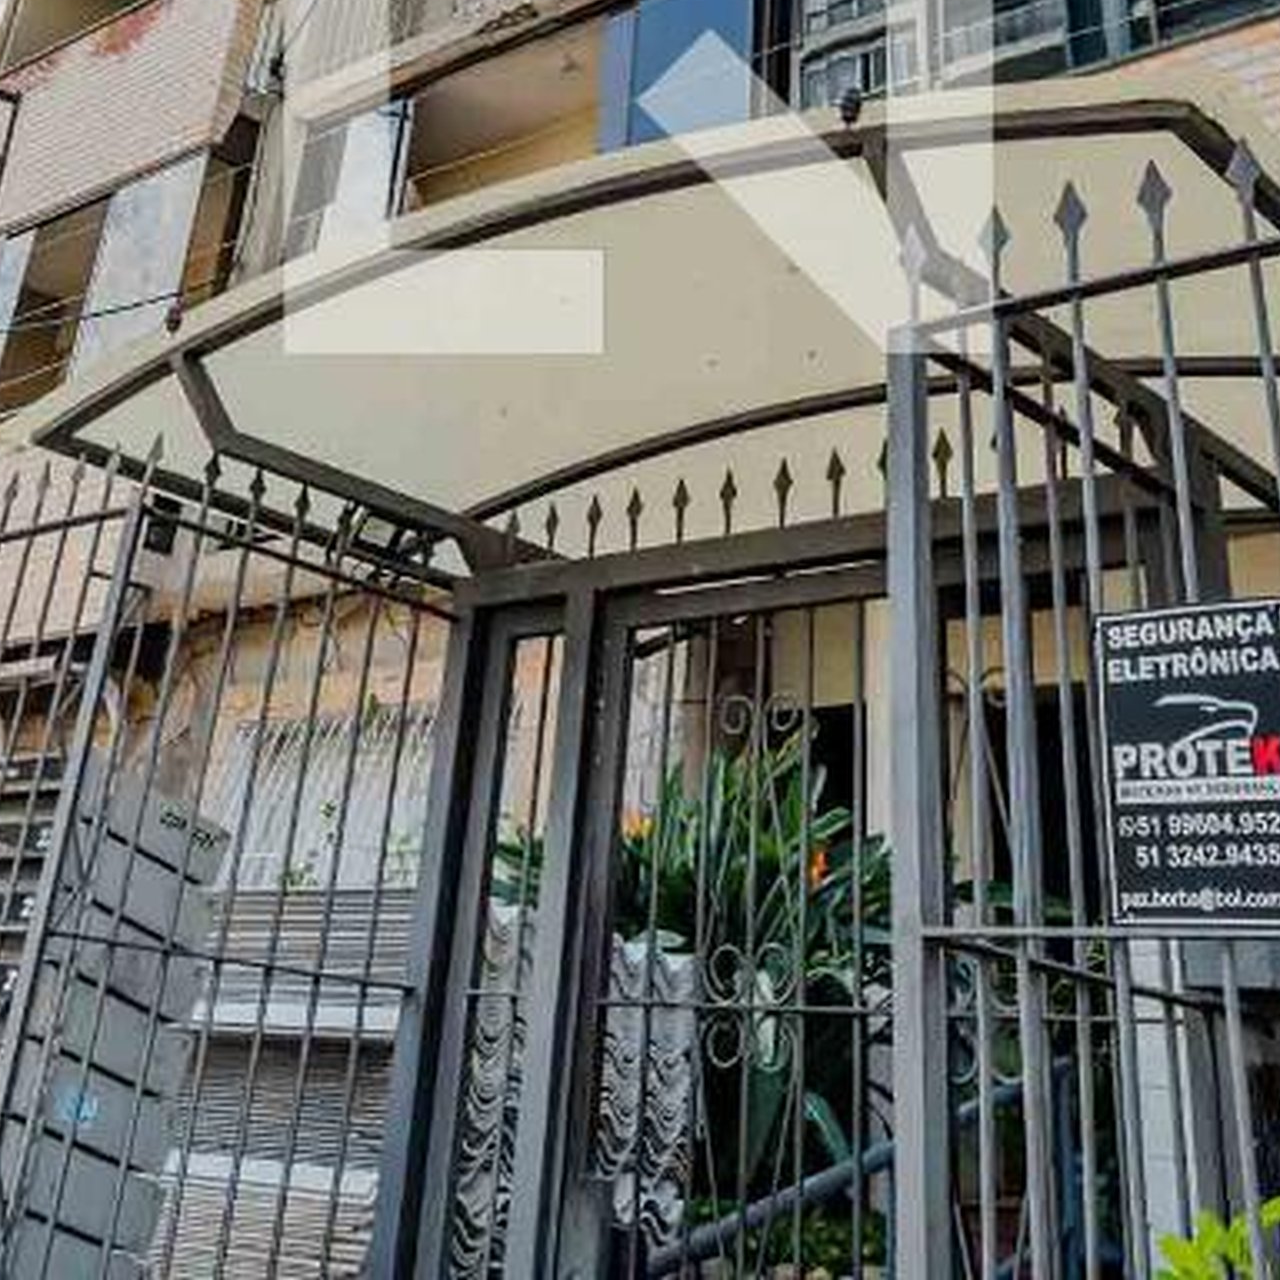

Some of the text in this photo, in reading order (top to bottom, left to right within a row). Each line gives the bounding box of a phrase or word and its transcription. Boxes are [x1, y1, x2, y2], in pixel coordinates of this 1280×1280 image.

[1107, 611, 1275, 649] SEGURANÇA
[1107, 645, 1280, 683] ELETRÔNICA
[1138, 814, 1162, 838] 51
[1135, 845, 1160, 869] 51
